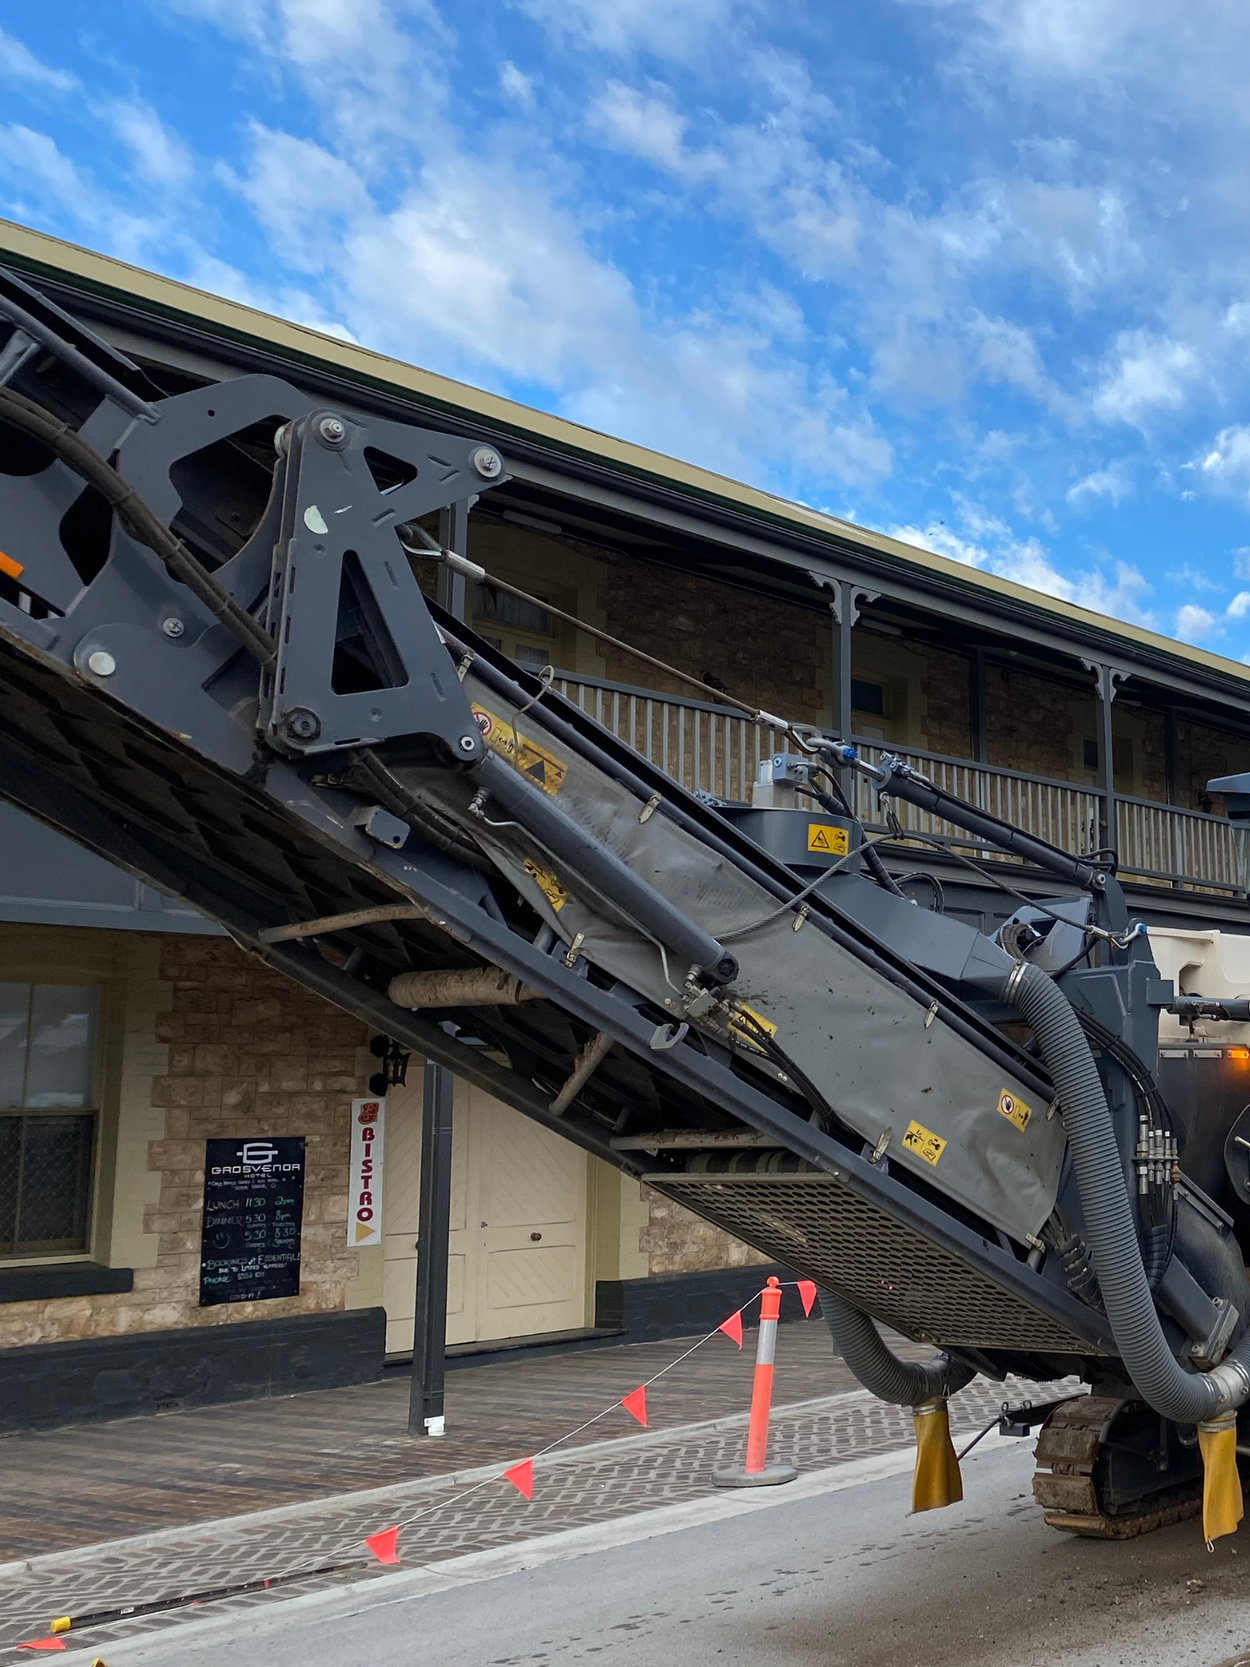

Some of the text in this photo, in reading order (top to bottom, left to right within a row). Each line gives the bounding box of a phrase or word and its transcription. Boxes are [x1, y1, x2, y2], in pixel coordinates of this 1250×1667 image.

[211, 1163, 301, 1175] GROSVENOR
[356, 1127, 375, 1222] BISTRO
[206, 1199, 240, 1211] LUNCH
[205, 1216, 244, 1228] DINNER
